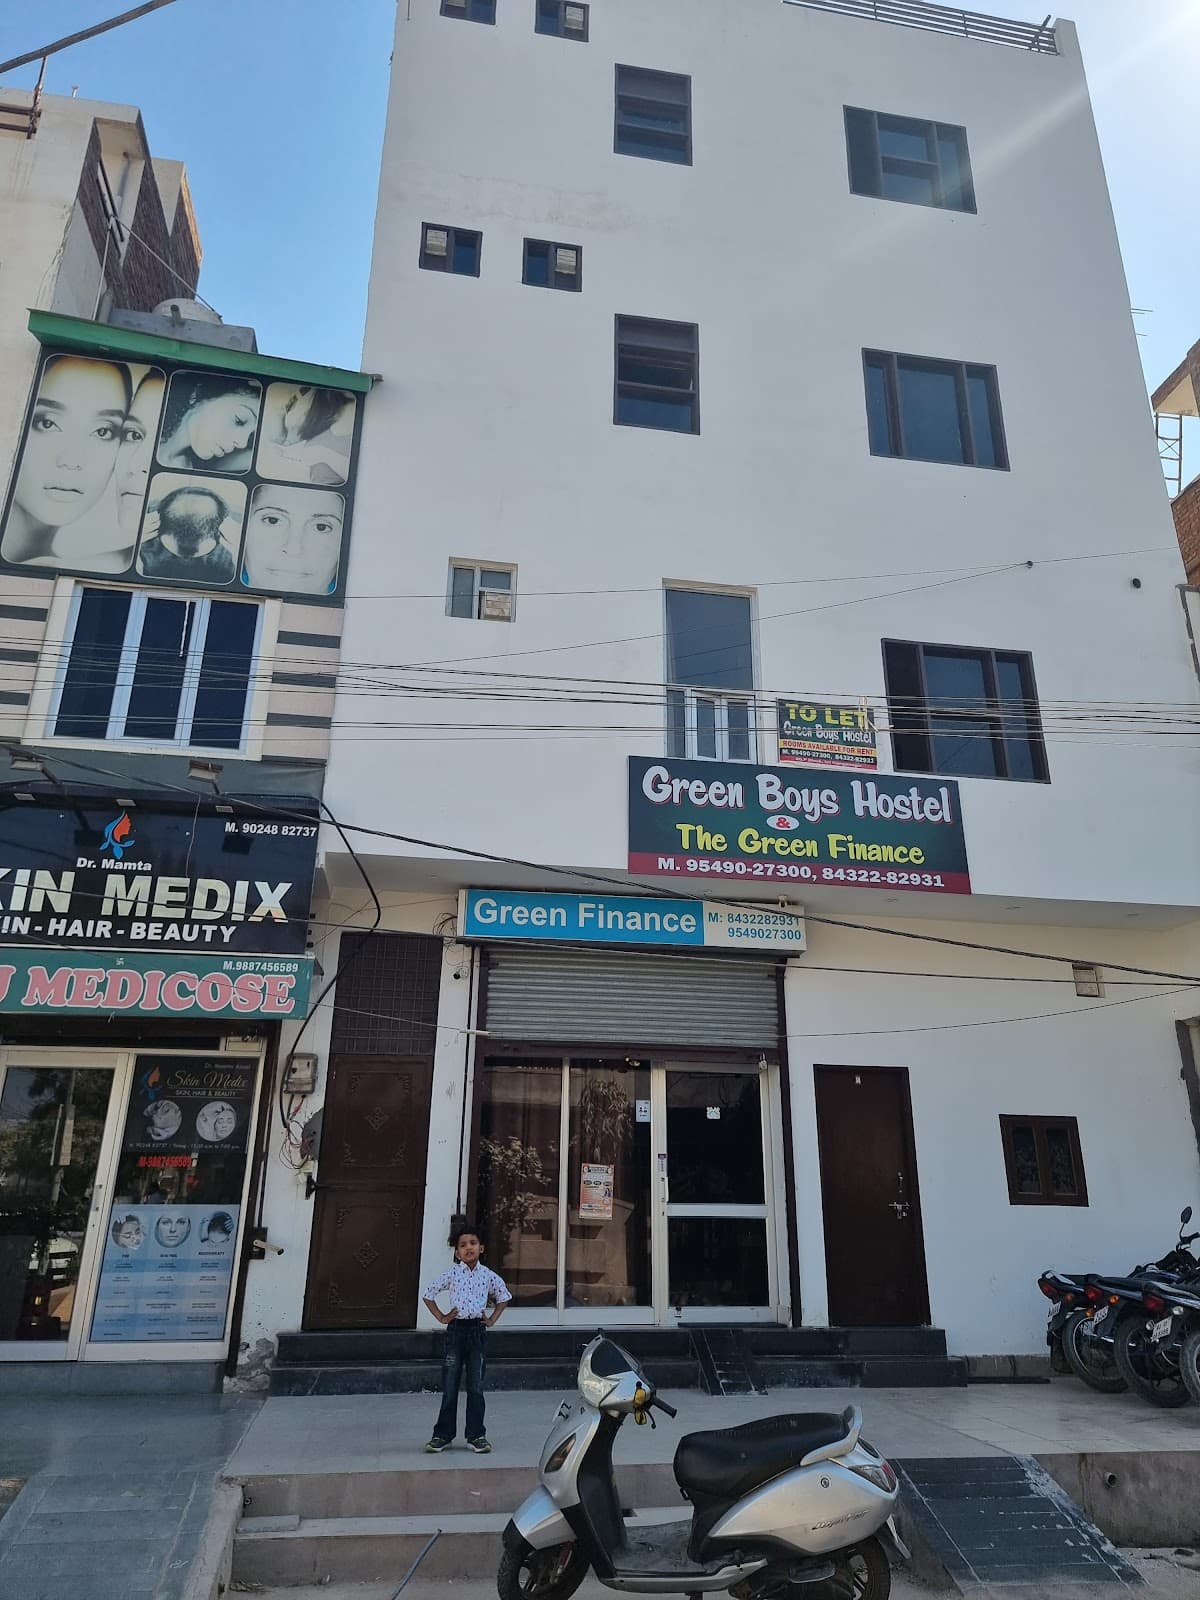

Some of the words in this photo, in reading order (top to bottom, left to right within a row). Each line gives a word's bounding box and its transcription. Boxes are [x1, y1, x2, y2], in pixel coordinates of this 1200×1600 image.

[785, 704, 817, 721] TO
[825, 707, 866, 728] LET
[784, 720, 812, 737] Green
[815, 723, 839, 743] Boys
[842, 727, 872, 743] Hostel
[783, 739, 807, 748] ROOMS
[808, 741, 841, 752] AVAILABLE
[842, 745, 856, 753] FOR
[857, 747, 873, 756] RENT
[642, 765, 744, 809] Green
[756, 773, 839, 822] Boys
[850, 780, 952, 823] Hostel
[225, 822, 239, 833] M.
[242, 822, 278, 835] 90248
[281, 825, 317, 837] 82737
[776, 817, 791, 829] &
[675, 823, 728, 852] The
[737, 828, 818, 858] Green
[826, 833, 925, 865] Finance
[76, 857, 97, 868] Dr.
[101, 858, 152, 871] Mamta
[658, 857, 681, 871] M.
[686, 859, 817, 881] 95490-27300,
[822, 867, 945, 887] 84322-82931
[101, 874, 293, 923] MEDIX
[474, 898, 567, 927] Green
[578, 902, 697, 933] Finance
[708, 912, 723, 923] M:
[727, 912, 800, 926] 8432282931
[130, 922, 237, 943] BEAUTY
[728, 928, 801, 940] 9549027300
[223, 960, 299, 972] M.9887456589
[21, 966, 296, 1013] MEDICOSE
[167, 1070, 200, 1089] Skin
